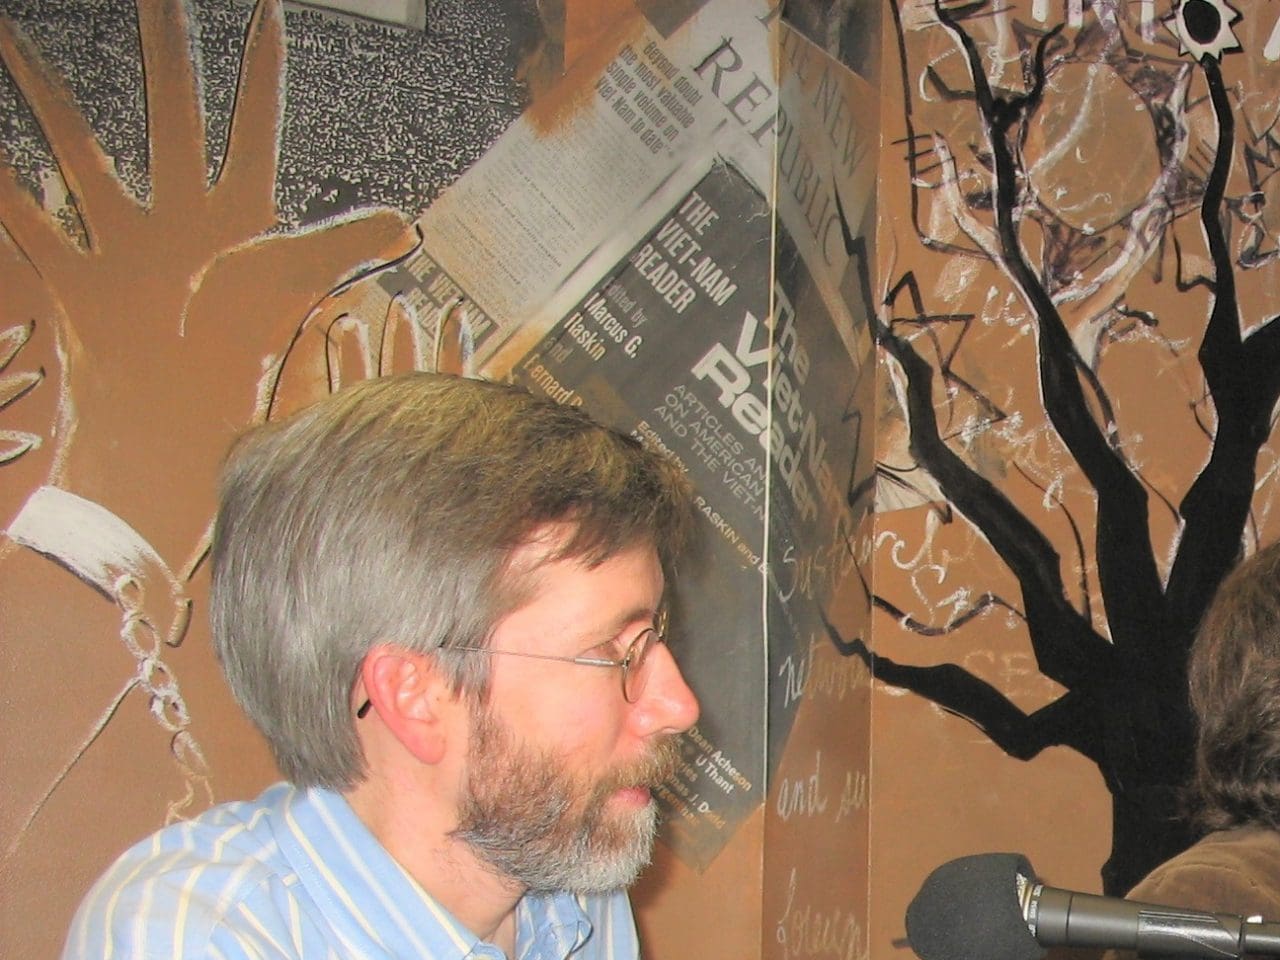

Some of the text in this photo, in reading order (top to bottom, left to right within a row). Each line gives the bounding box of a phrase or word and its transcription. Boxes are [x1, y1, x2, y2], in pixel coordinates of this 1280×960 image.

[605, 61, 637, 95] single
[633, 89, 668, 129] volume
[633, 61, 662, 91] most
[656, 86, 696, 129] valuable
[693, 34, 846, 268] REPUBLIC
[679, 190, 720, 237] THE
[631, 243, 697, 315] READER
[655, 217, 739, 307] VIET-NAM
[583, 292, 628, 345] Marcus
[631, 307, 649, 329] by
[653, 404, 688, 440] AND
[691, 438, 722, 474] THE
[664, 392, 766, 498] ON AMERICAN
[672, 384, 746, 457] ARTICLES
[694, 495, 741, 546] RASKIN
[694, 753, 736, 795] U Thant
[711, 749, 753, 792] Acheson
